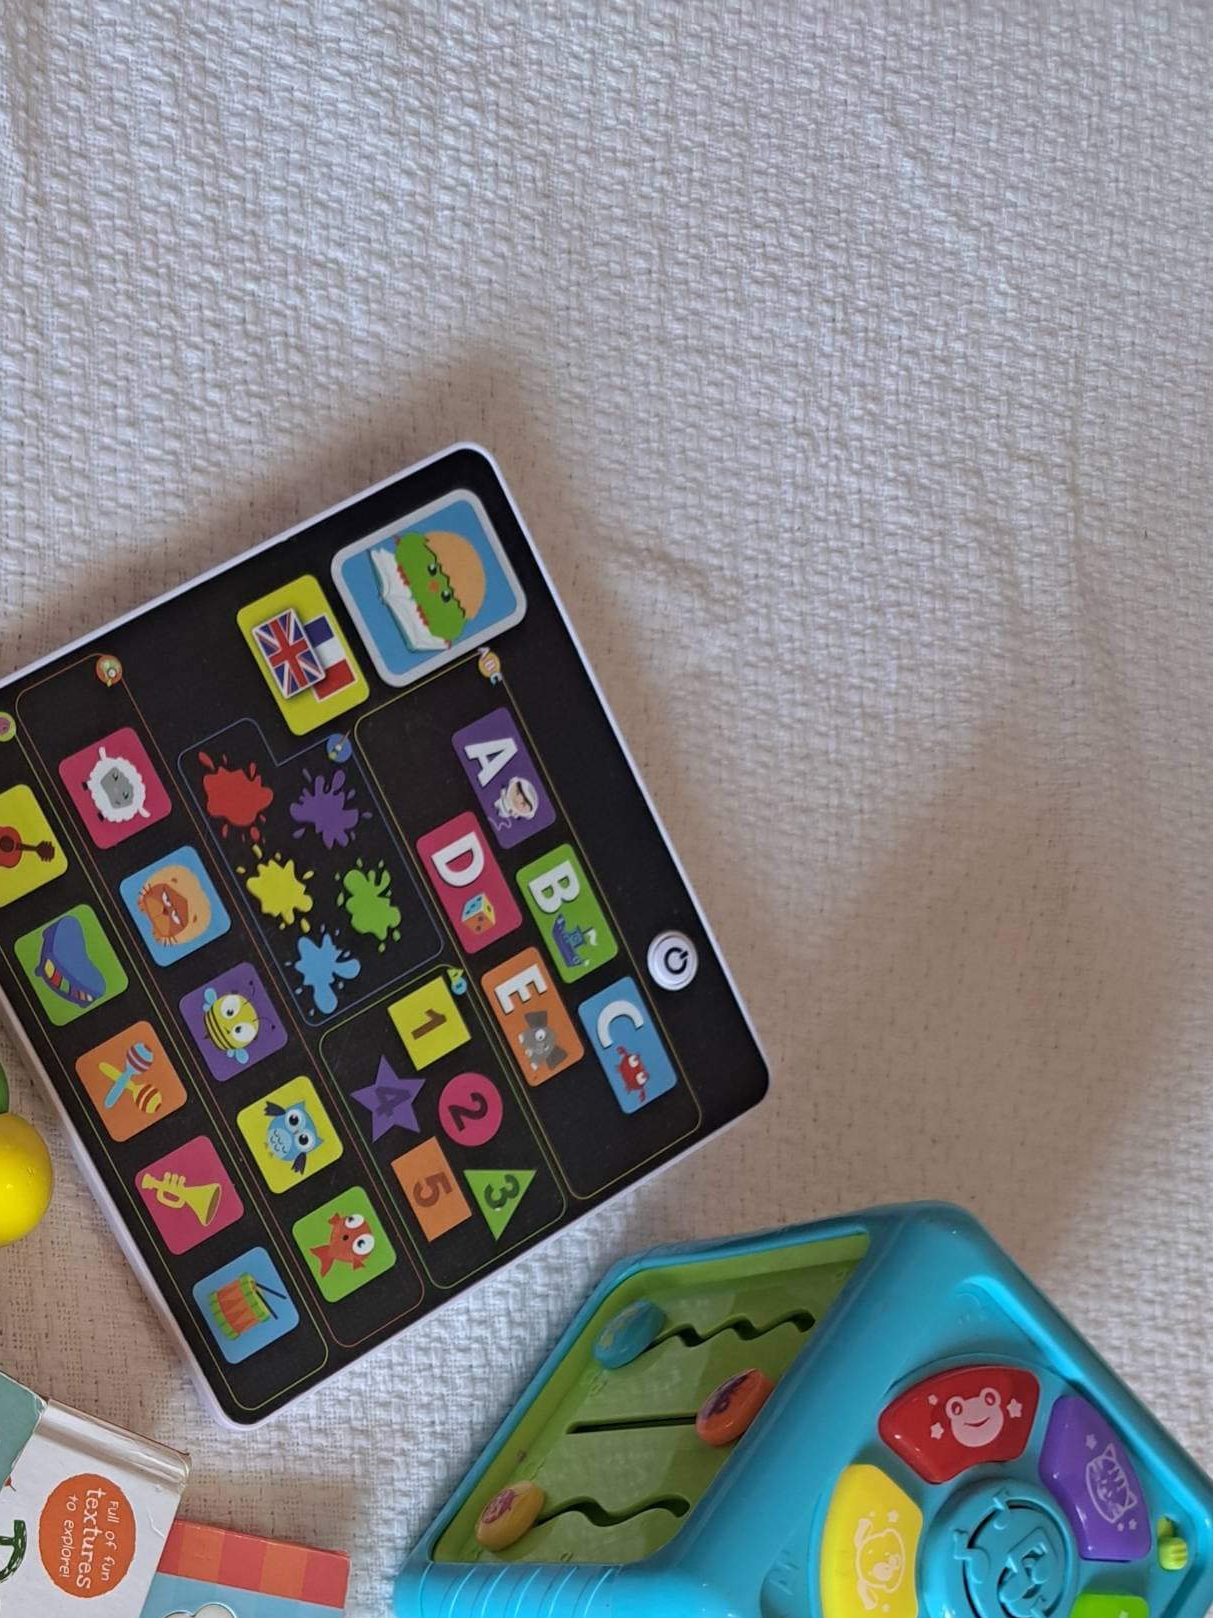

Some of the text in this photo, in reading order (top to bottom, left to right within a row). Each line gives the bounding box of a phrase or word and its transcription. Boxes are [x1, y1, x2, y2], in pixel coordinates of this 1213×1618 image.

[464, 736, 518, 788] A
[431, 831, 485, 887] D
[528, 859, 580, 914] B
[494, 964, 547, 1014] E
[411, 1008, 447, 1040] 1
[597, 999, 644, 1048] C
[375, 1086, 411, 1119] 4
[448, 1092, 488, 1132] 2
[413, 1171, 452, 1207] 5
[484, 1174, 520, 1210] 3
[59, 1494, 79, 1578] to explore!
[76, 1487, 107, 1589] textures
[100, 1500, 121, 1581] Full of fun
